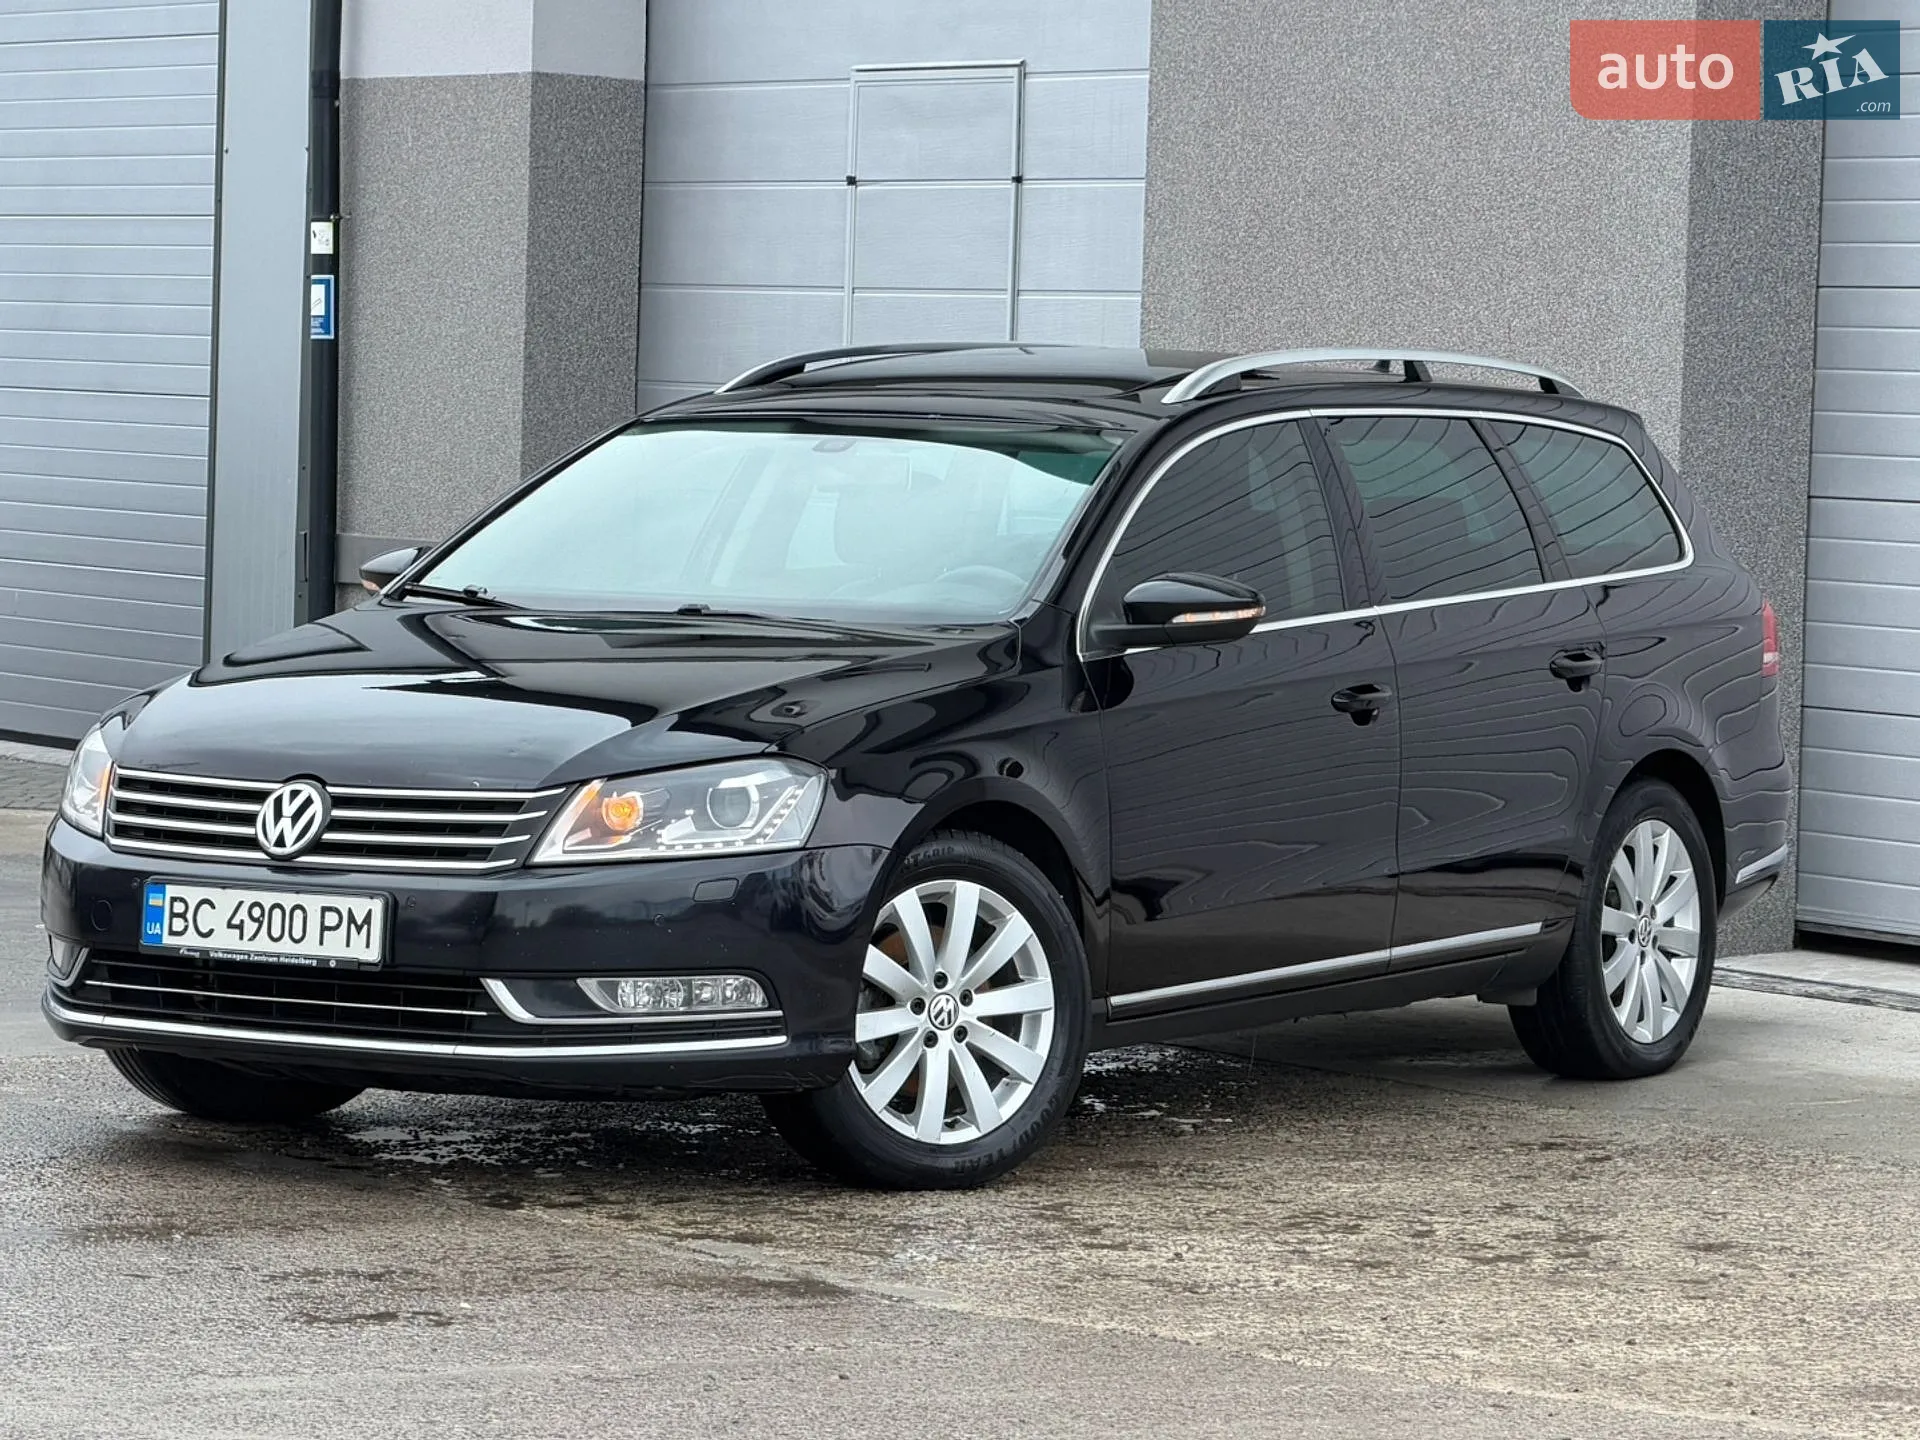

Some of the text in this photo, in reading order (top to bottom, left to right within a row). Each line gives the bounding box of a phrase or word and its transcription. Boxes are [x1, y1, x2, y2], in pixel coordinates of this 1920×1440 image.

[146, 922, 161, 936] UA
[168, 896, 373, 949] BC 4900 PM
[209, 950, 248, 961] Volkswagen
[249, 953, 278, 963] Zentrum
[279, 956, 317, 967] Heidelberg
